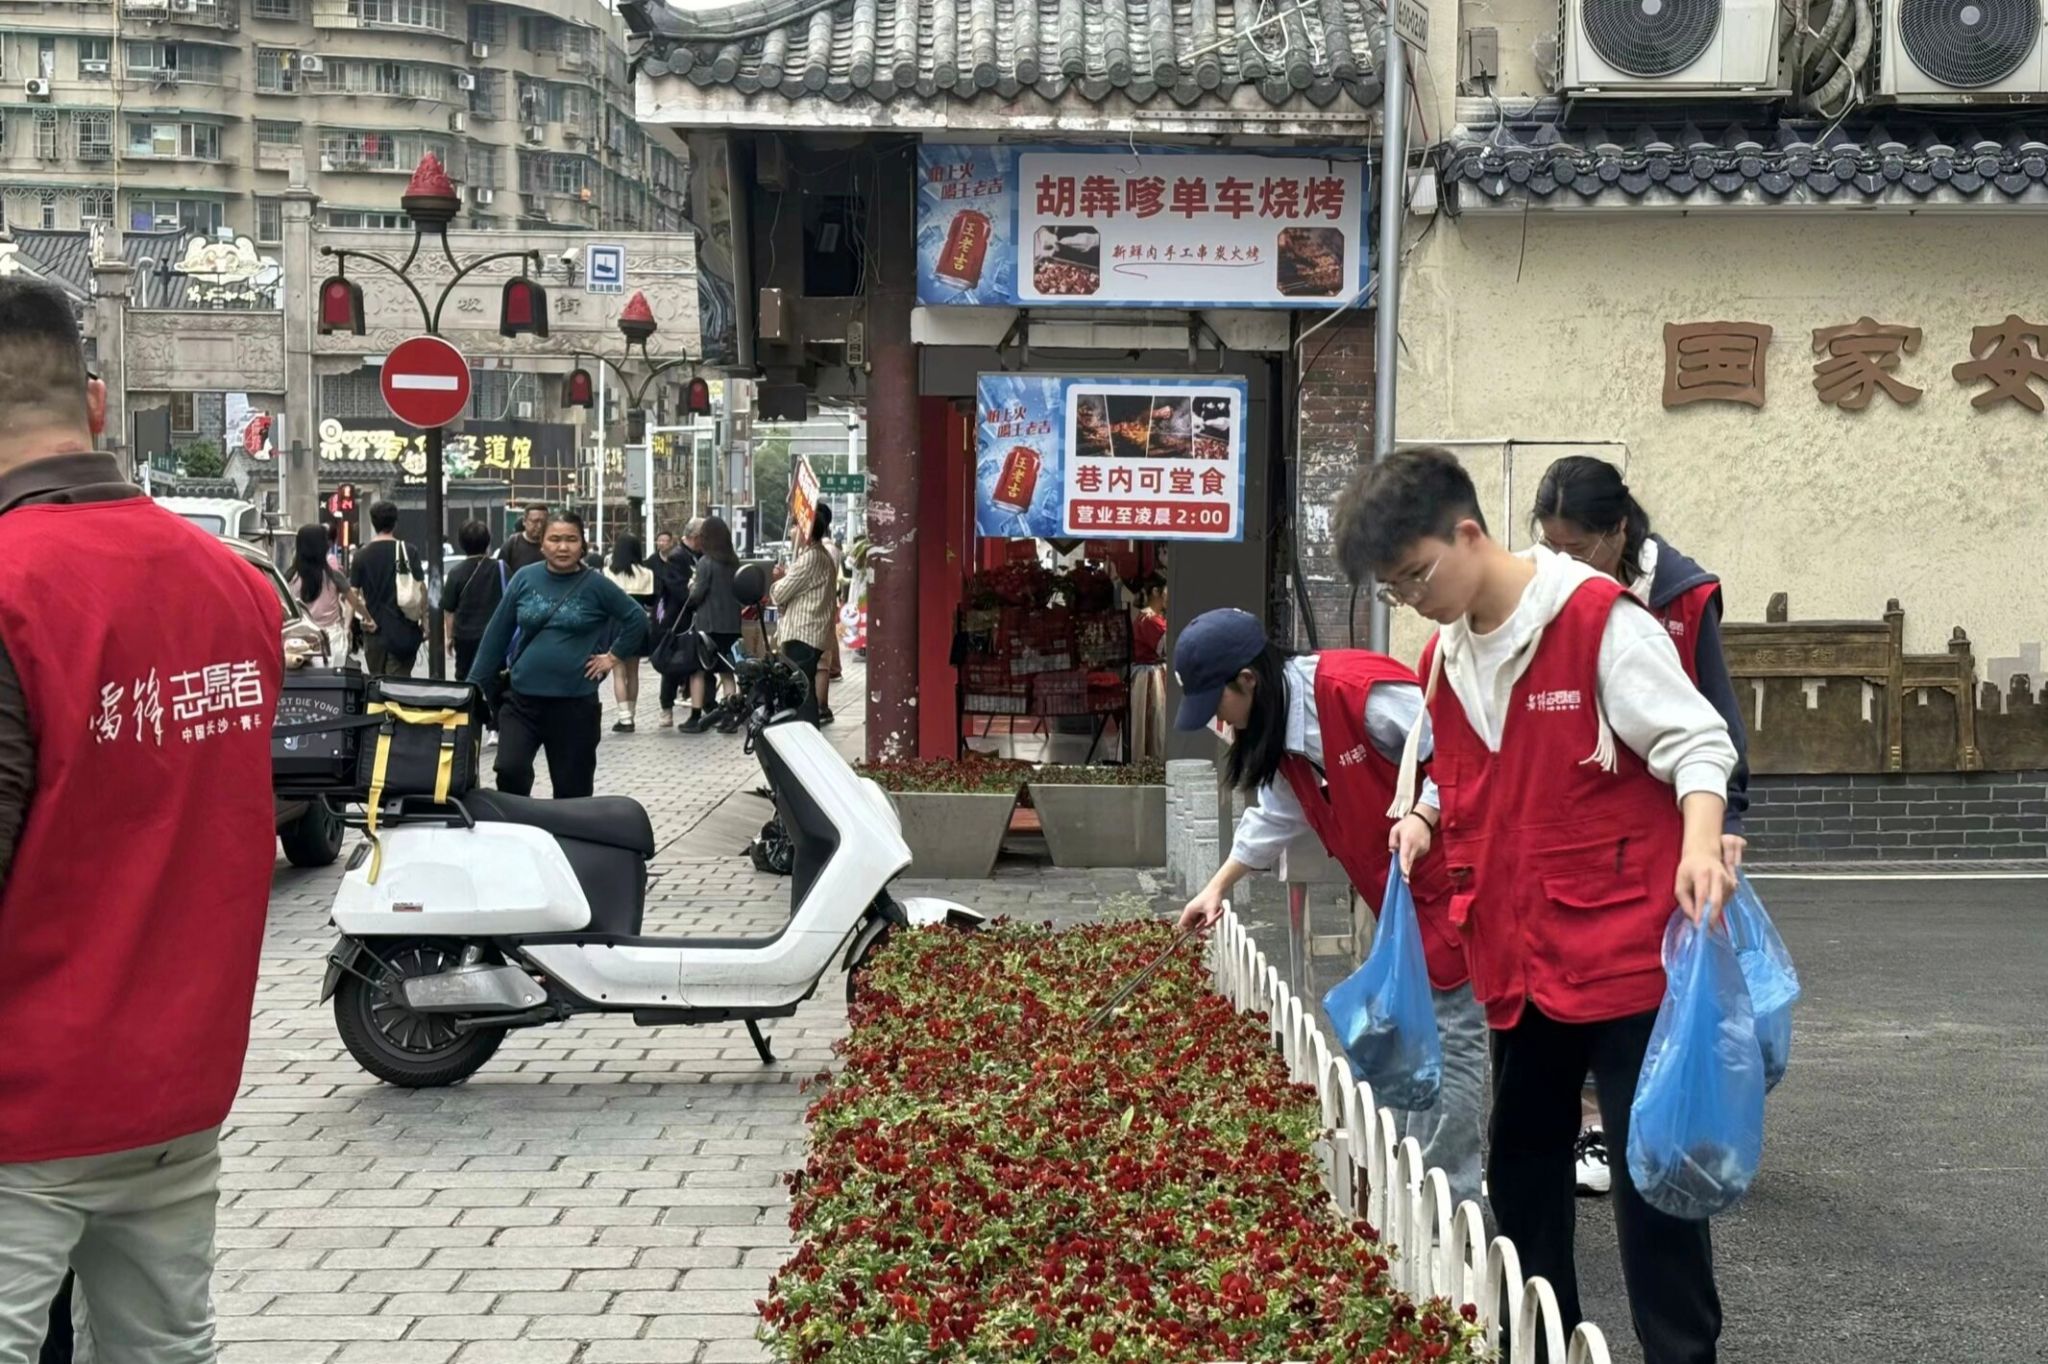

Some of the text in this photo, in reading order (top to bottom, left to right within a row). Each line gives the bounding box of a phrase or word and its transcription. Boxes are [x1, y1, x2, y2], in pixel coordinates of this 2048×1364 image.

[953, 222, 976, 271] 王老吉
[1662, 314, 2048, 413] 国家安
[1075, 464, 1226, 496] 巷内可堂食
[169, 659, 263, 721] 志愿者
